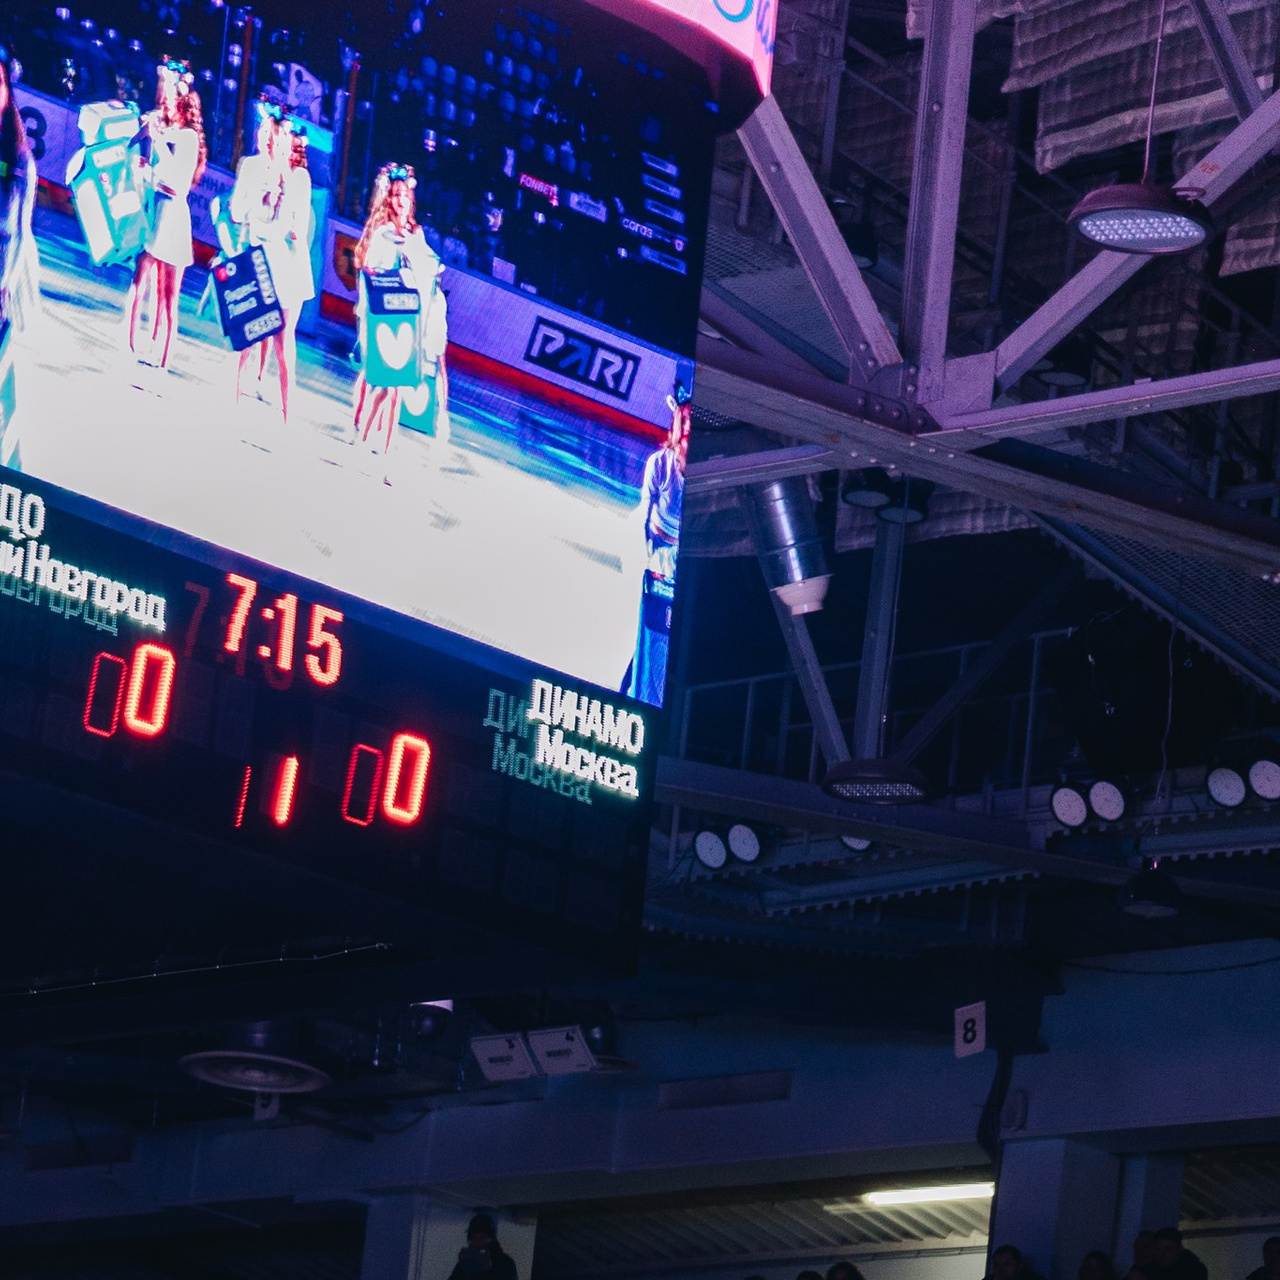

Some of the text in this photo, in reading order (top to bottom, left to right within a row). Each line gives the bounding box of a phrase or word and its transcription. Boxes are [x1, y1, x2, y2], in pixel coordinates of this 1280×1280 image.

[530, 323, 635, 394] PARI
[224, 572, 345, 686] 7:15
[528, 677, 646, 757] ДИНАМО
[533, 723, 640, 799] Москва
[963, 1018, 977, 1044] 8
